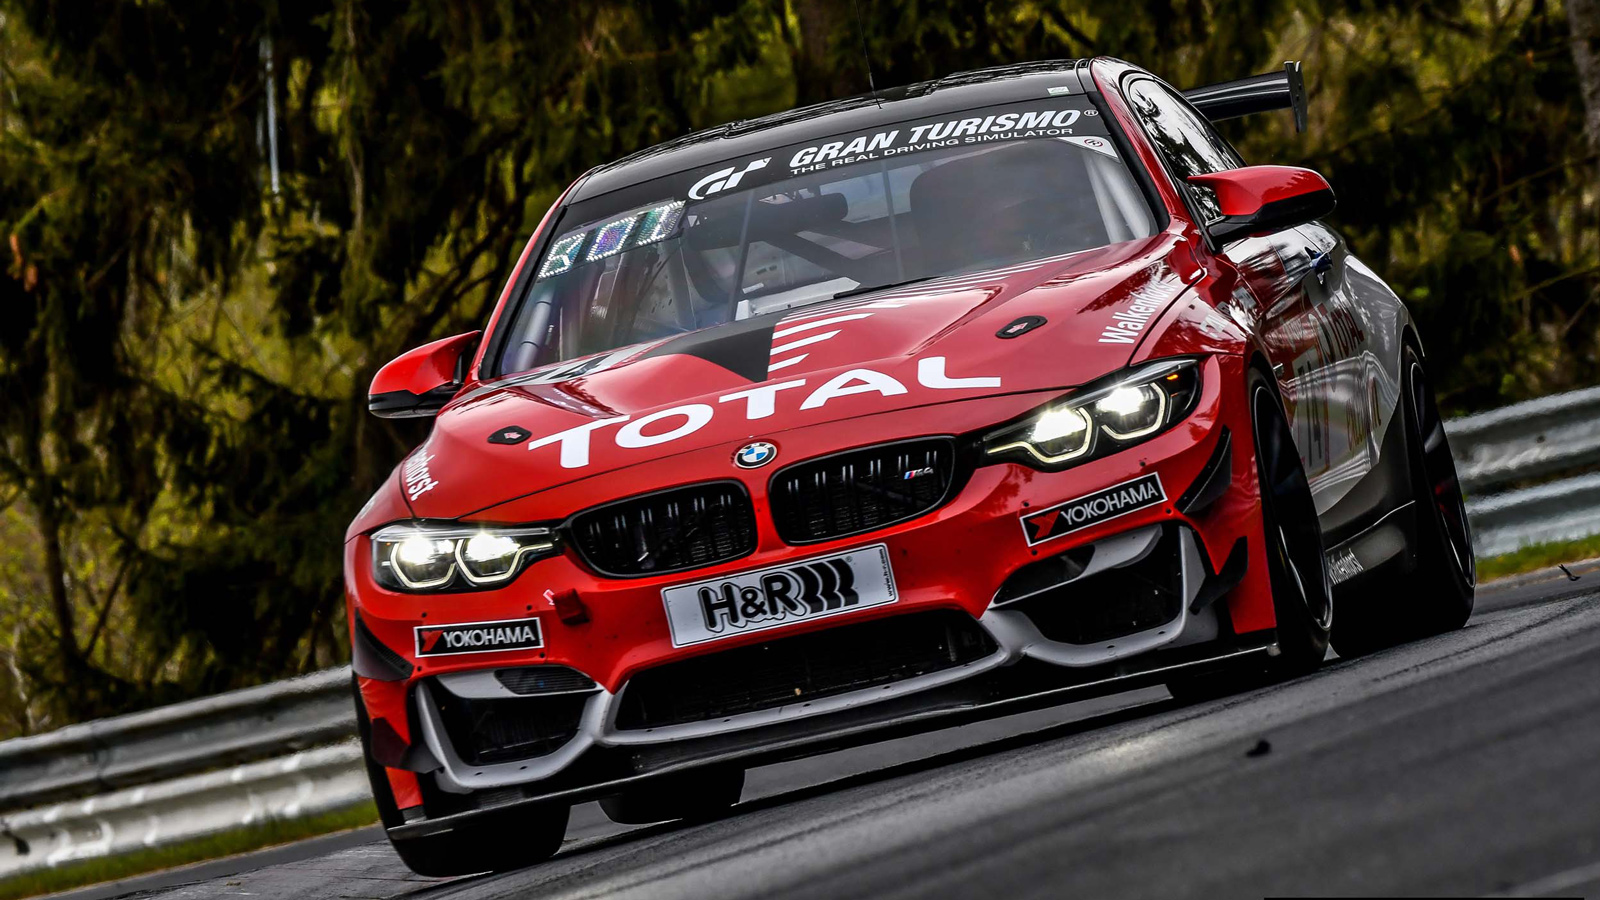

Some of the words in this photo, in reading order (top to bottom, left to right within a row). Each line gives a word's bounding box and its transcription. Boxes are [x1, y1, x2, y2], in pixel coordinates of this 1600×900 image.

[789, 130, 900, 168] GRAN
[908, 109, 1081, 144] TURISMO
[790, 162, 826, 175] THE
[831, 154, 879, 167] REAL
[884, 139, 959, 156] DRIVING
[965, 128, 1073, 143] SIMULATOR
[528, 356, 1001, 468] TOTAL
[1060, 482, 1159, 526] YOKOHAMA
[698, 570, 812, 633] H&R
[442, 626, 536, 648] YOKOHAMA
